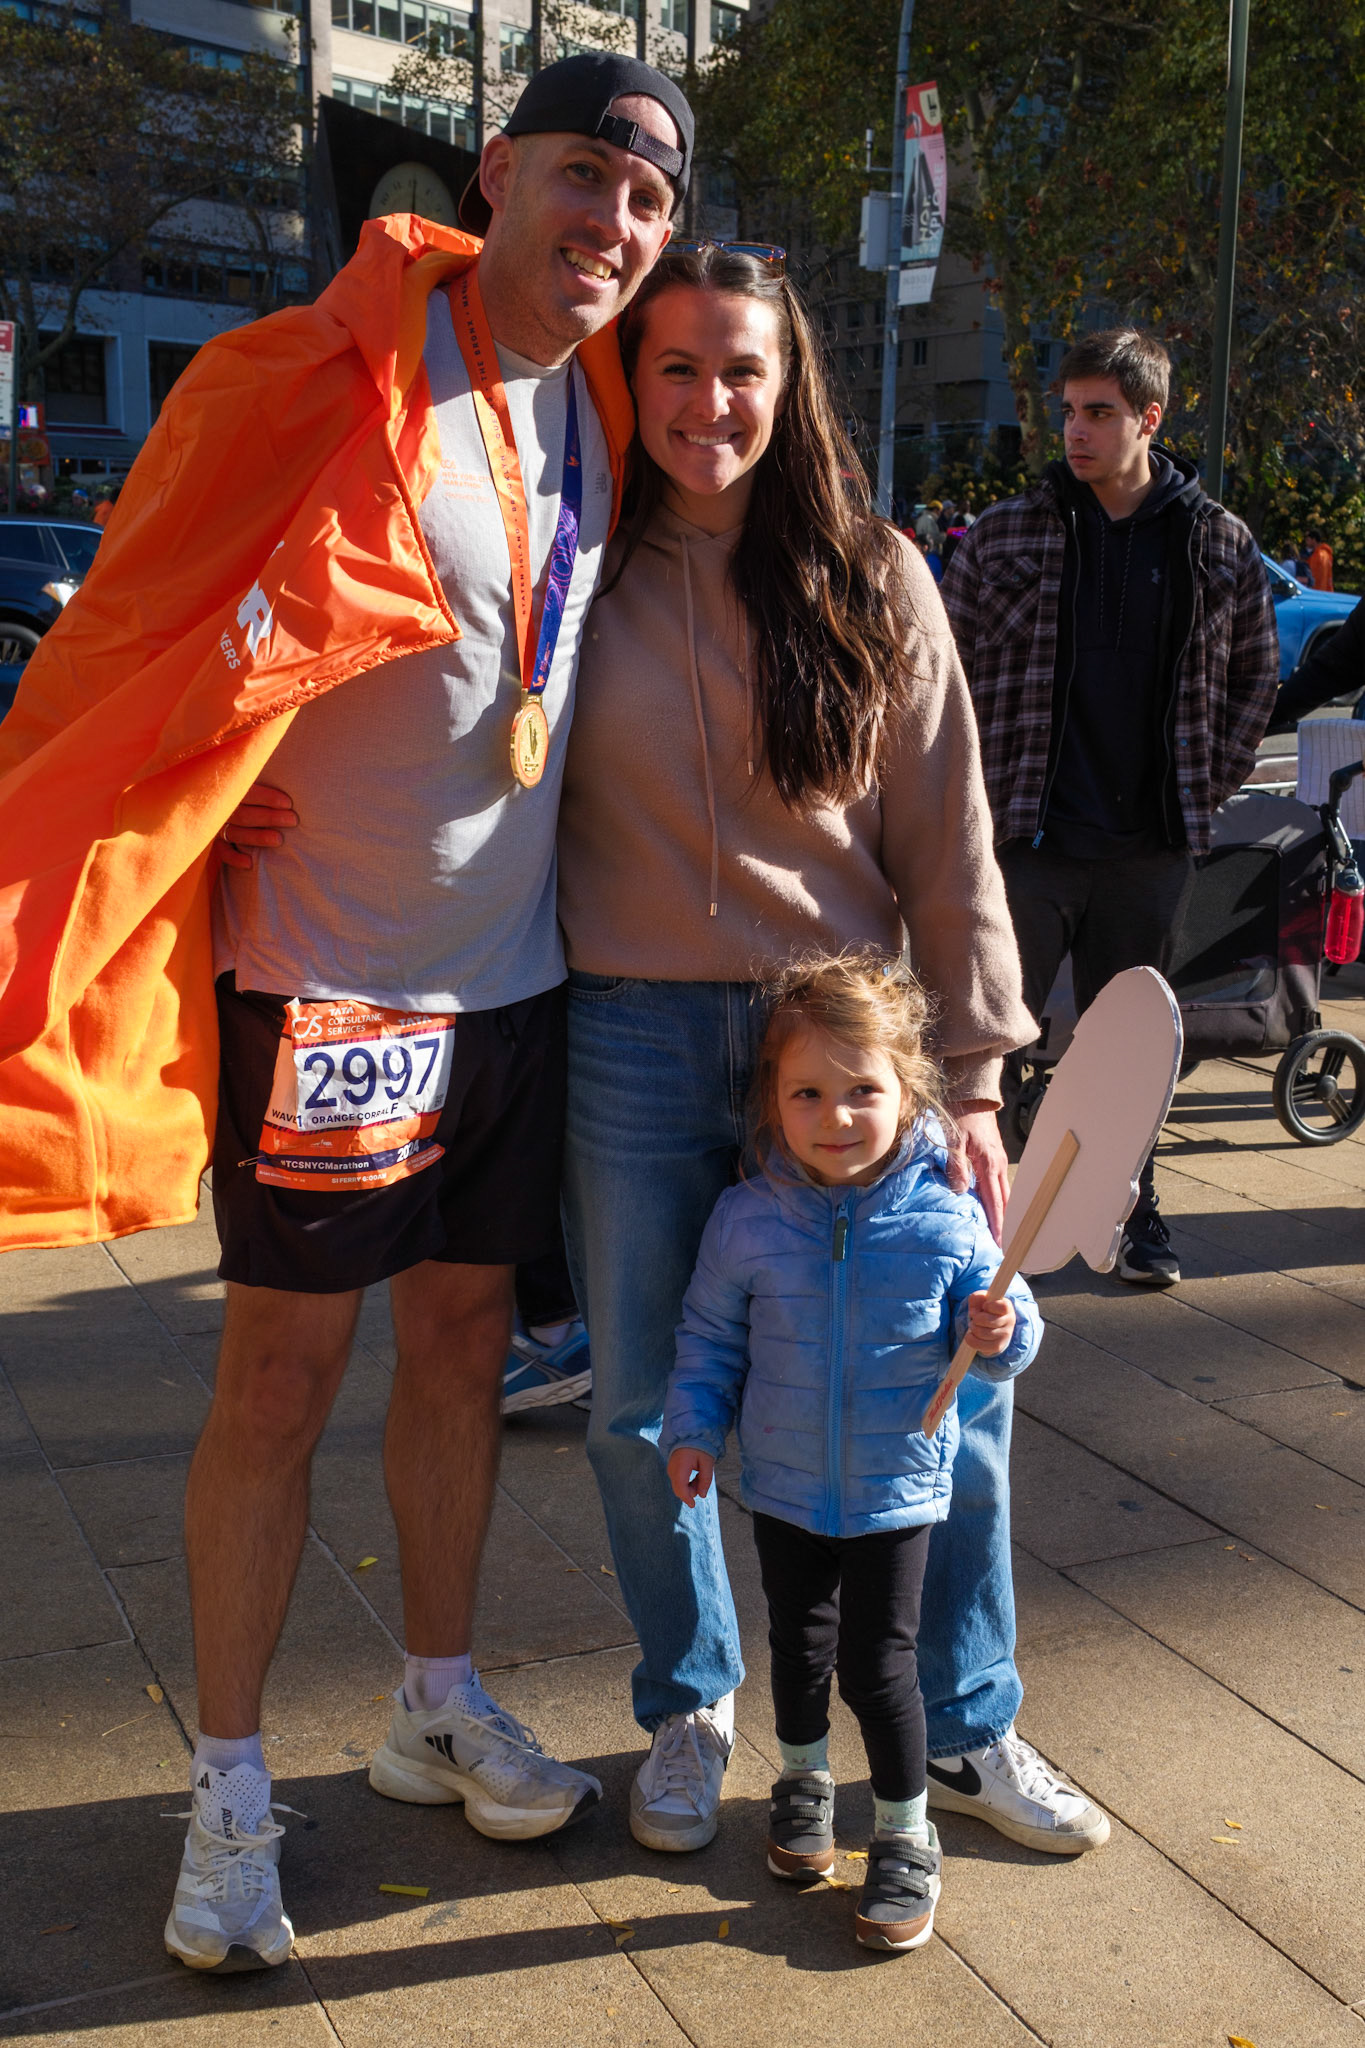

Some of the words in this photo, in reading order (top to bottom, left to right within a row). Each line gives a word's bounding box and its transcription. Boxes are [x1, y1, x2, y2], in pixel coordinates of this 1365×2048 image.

[466, 319, 481, 356] BRONX
[477, 361, 487, 381] THE
[500, 455, 517, 512] BROOKLYN
[515, 528, 524, 568] ISLAND
[328, 1006, 355, 1016] TATA
[398, 1014, 433, 1029] TATA
[327, 1025, 366, 1036] SERVICES
[303, 1037, 440, 1109] 2997
[296, 1114, 303, 1128] 1
[311, 1113, 355, 1125] ORANGE
[357, 1108, 389, 1121] CORRAL
[390, 1102, 399, 1115] F
[397, 1141, 420, 1163] 2024
[340, 1176, 361, 1184] FERRY
[362, 1173, 387, 1183] 6:00AM
[221, 1807, 239, 1856] ADIZEO
